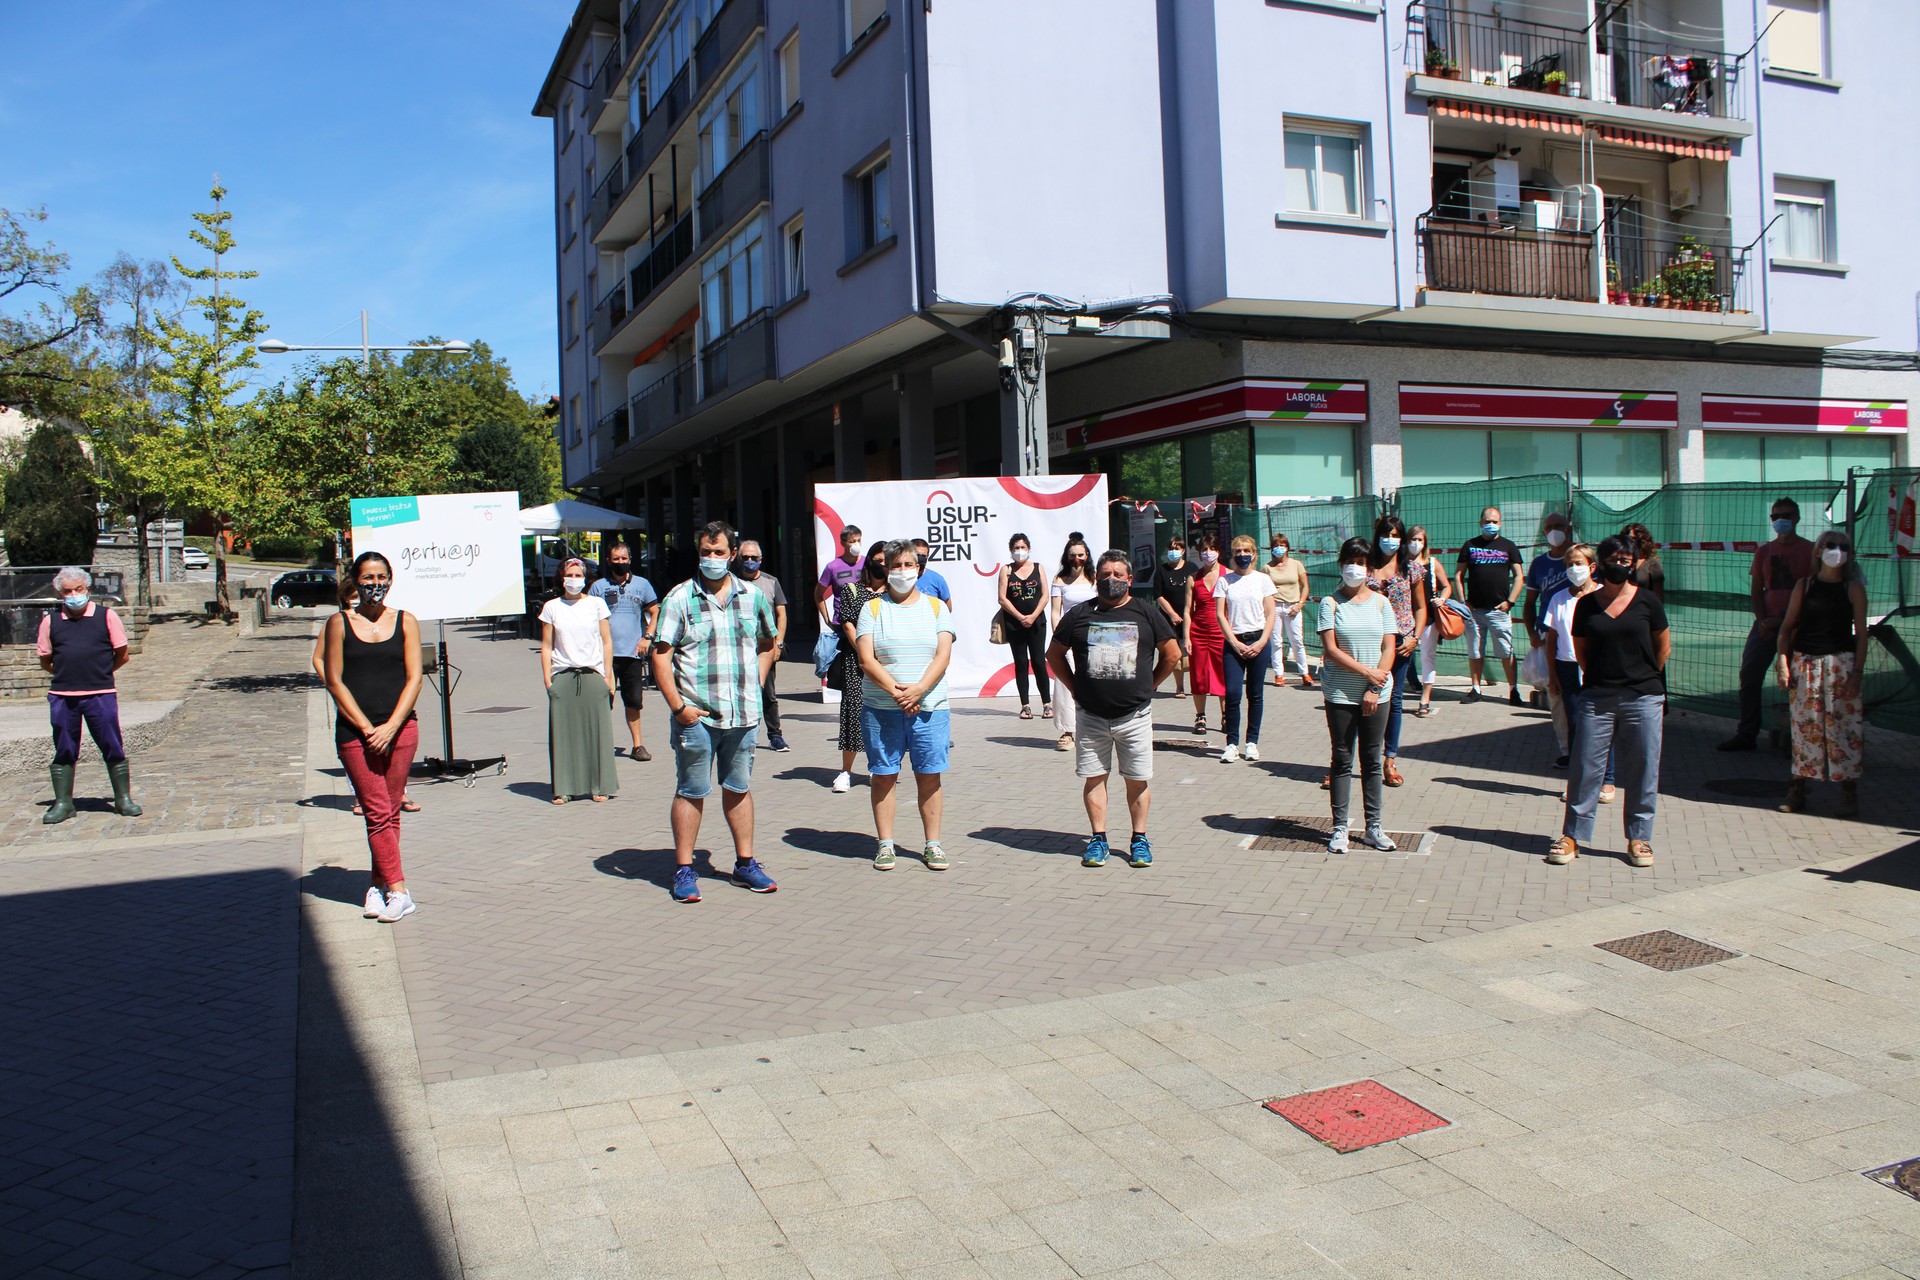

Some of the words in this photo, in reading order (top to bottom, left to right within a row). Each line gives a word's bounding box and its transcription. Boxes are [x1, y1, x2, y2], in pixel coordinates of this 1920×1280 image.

[1286, 392, 1327, 402] LABORAL
[926, 506, 997, 524] USUR-
[928, 525, 978, 543] BILT-
[402, 542, 480, 570] gertu@go
[928, 544, 971, 562] ZEN
